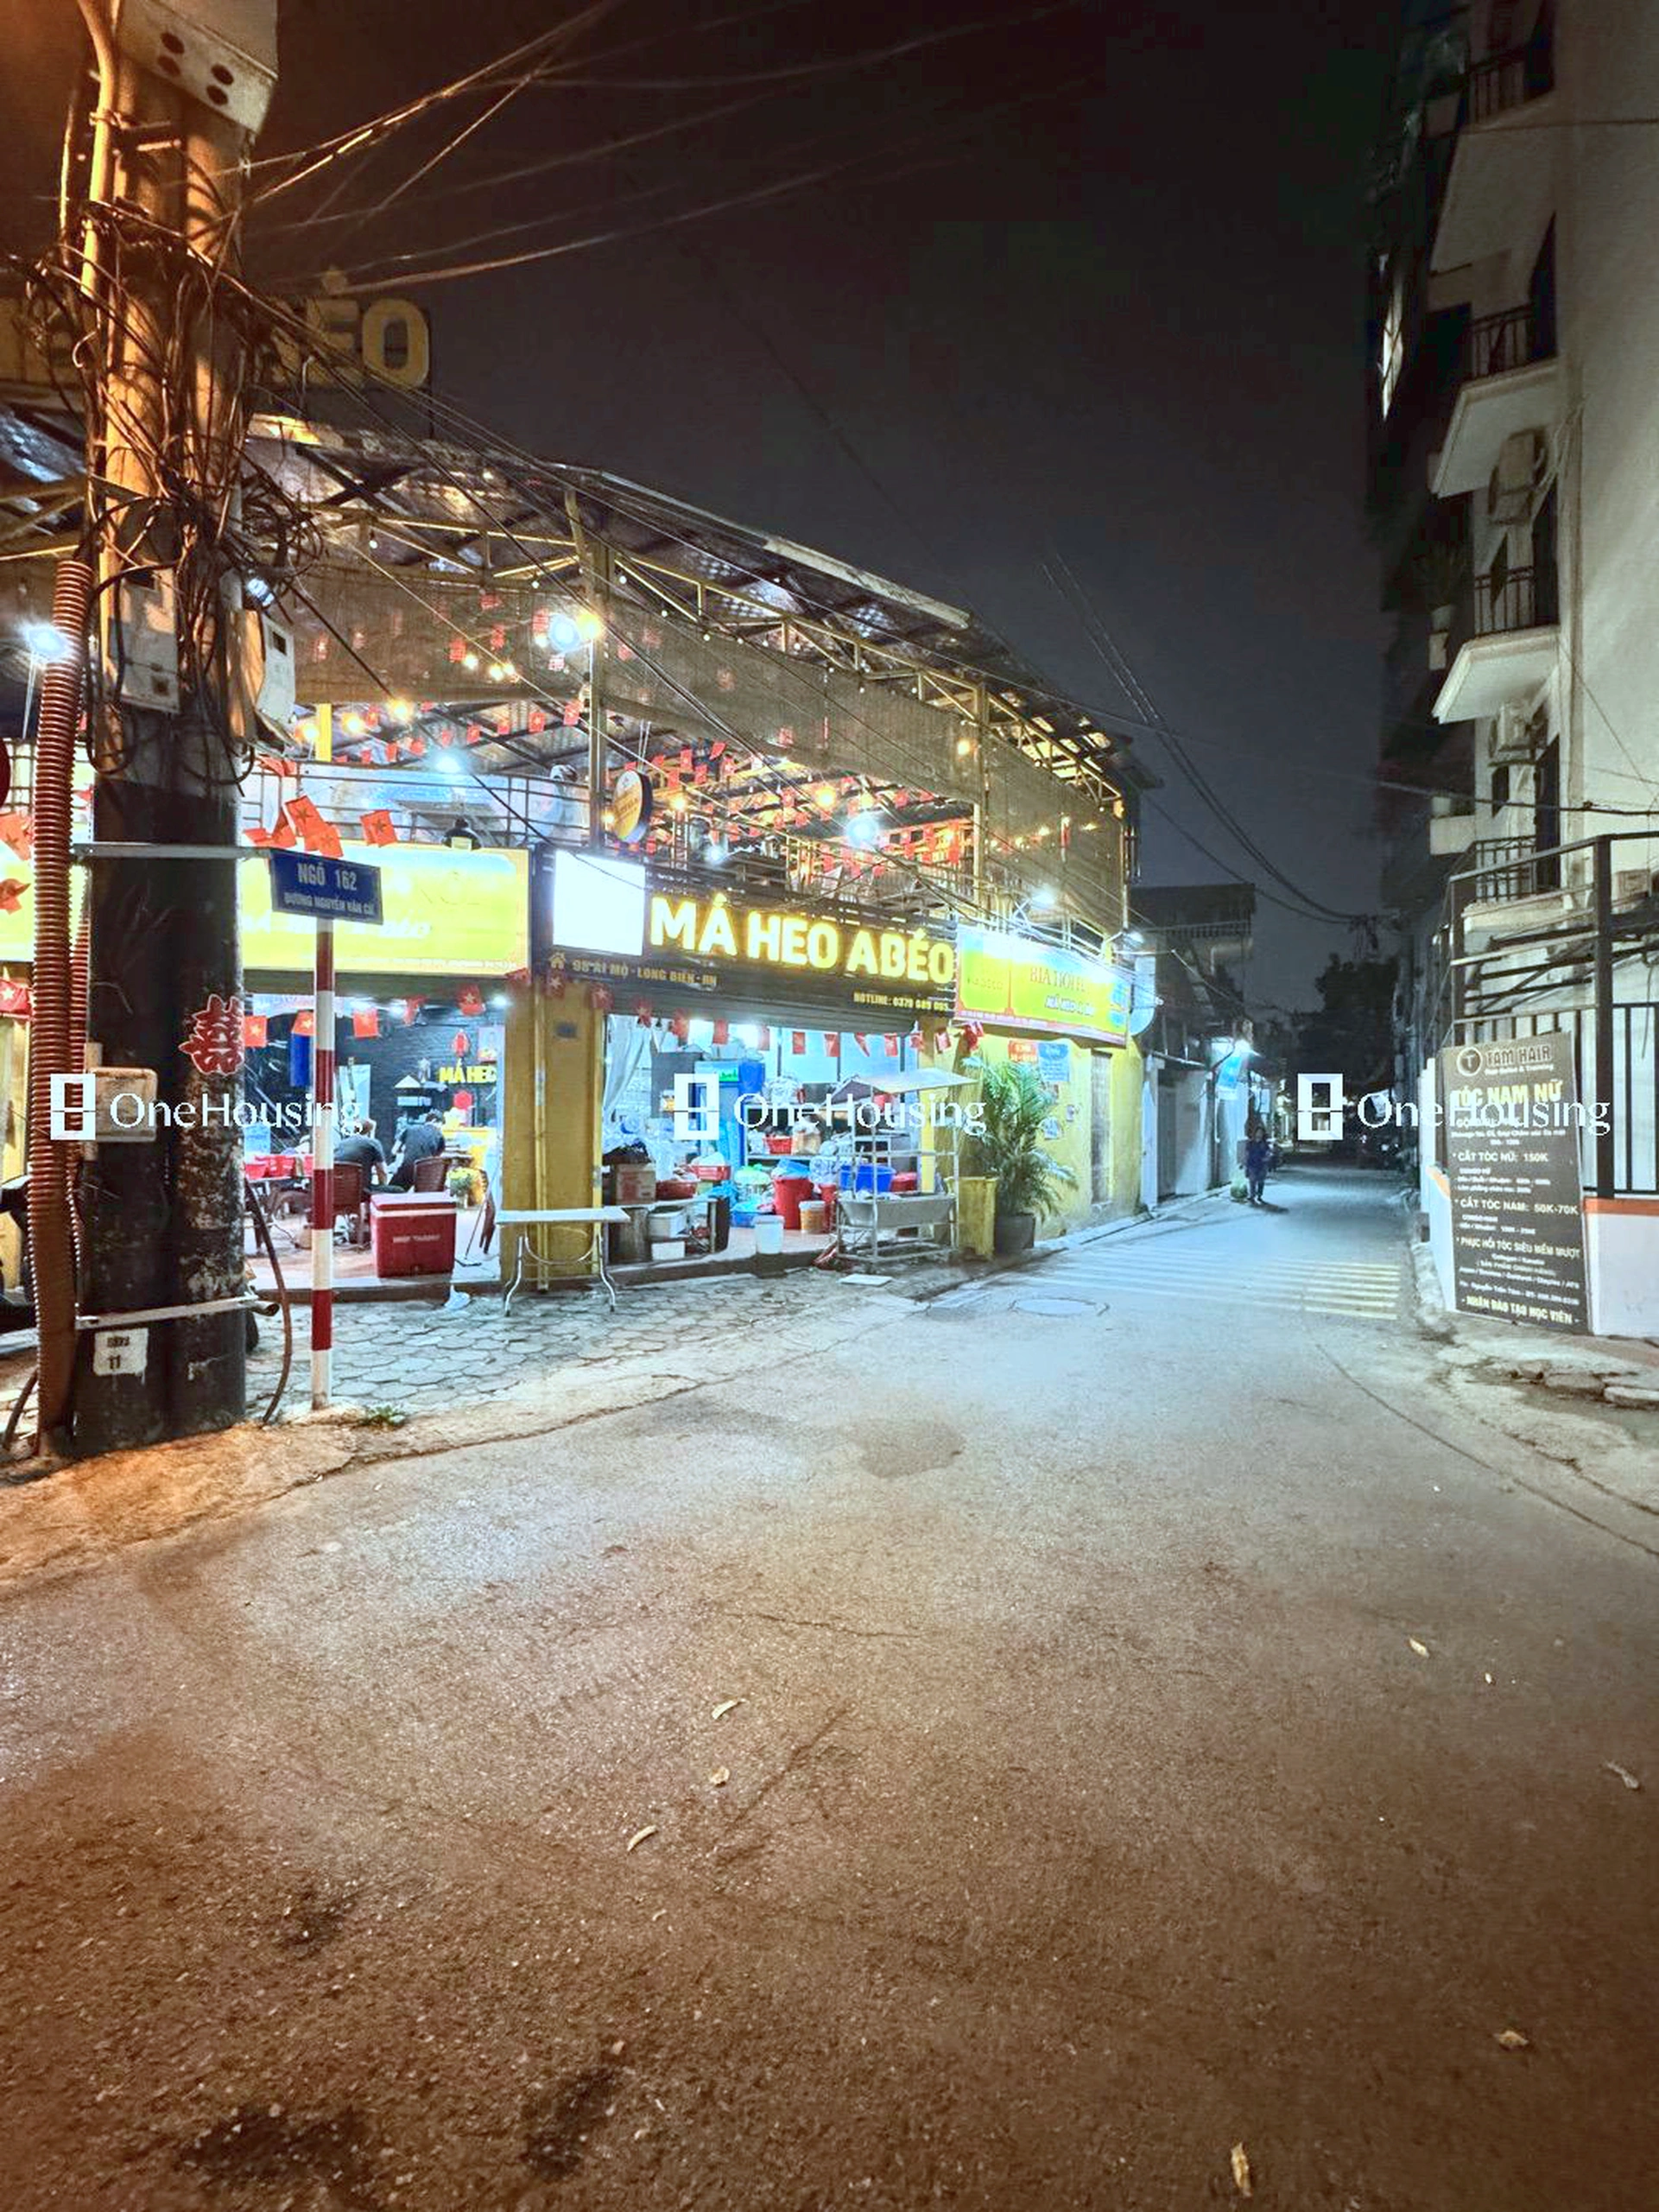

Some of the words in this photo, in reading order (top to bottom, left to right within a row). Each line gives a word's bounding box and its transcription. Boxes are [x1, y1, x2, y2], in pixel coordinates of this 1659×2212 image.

[334, 869, 357, 891] 162
[748, 910, 839, 968] HEO
[637, 967, 664, 981] LONG
[1517, 1044, 1552, 1064] HAIR
[1486, 1084, 1528, 1105] NAM
[1535, 1079, 1563, 1102] NỮ
[1523, 1152, 1549, 1163] 150K
